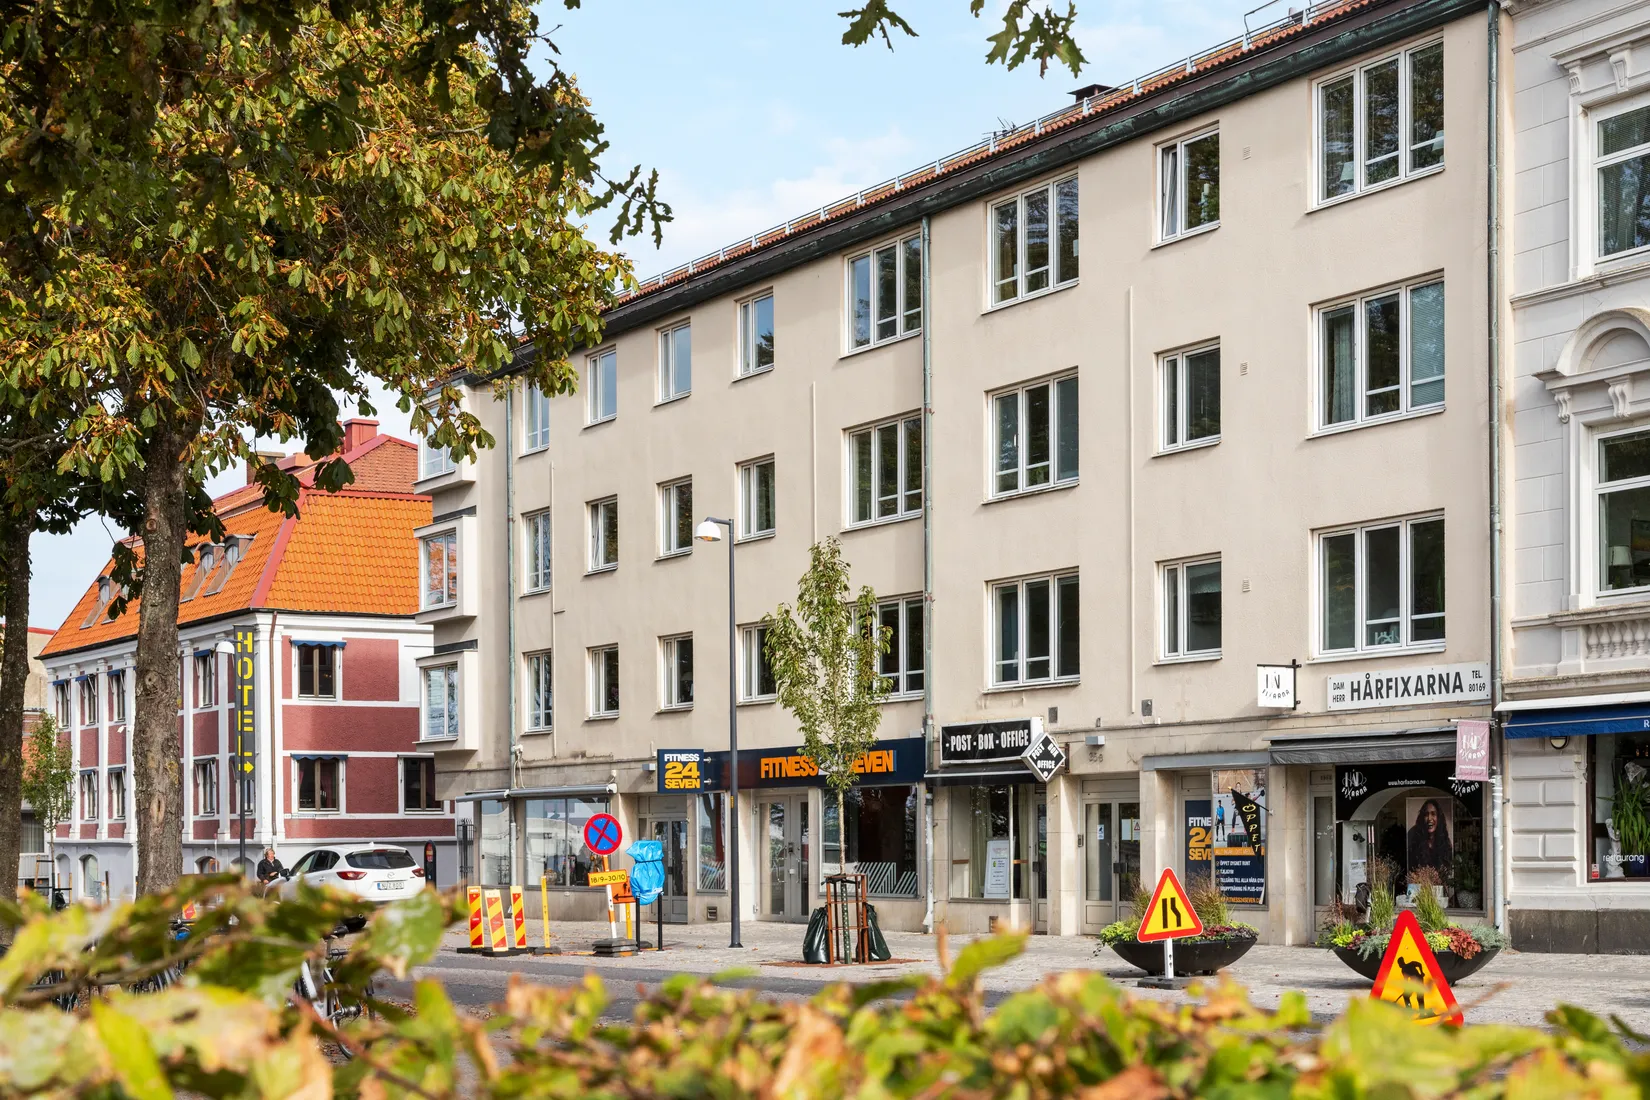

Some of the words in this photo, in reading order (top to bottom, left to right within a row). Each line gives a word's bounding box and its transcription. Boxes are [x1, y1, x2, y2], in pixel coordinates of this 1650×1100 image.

[1471, 670, 1483, 679] TEL.
[1332, 682, 1345, 691] DAM
[1350, 671, 1464, 701] HÅRFIXARNA
[1468, 682, 1486, 692] 80169
[237, 631, 253, 757] HOTEL
[1332, 694, 1346, 703] HERR
[950, 734, 972, 752] POST
[977, 733, 995, 750] BOX
[1000, 729, 1029, 749] OFFICE
[1031, 743, 1045, 760] POST
[1047, 743, 1059, 758] BOX
[664, 753, 700, 762] FITNESS
[664, 761, 700, 778] 24
[760, 755, 819, 779] FITNESS
[846, 749, 894, 774] EVEN
[1037, 759, 1056, 769] OFFICE
[664, 778, 701, 789] SEVEN
[1242, 803, 1260, 853] ÖPPET
[1602, 853, 1645, 863] restaurang
